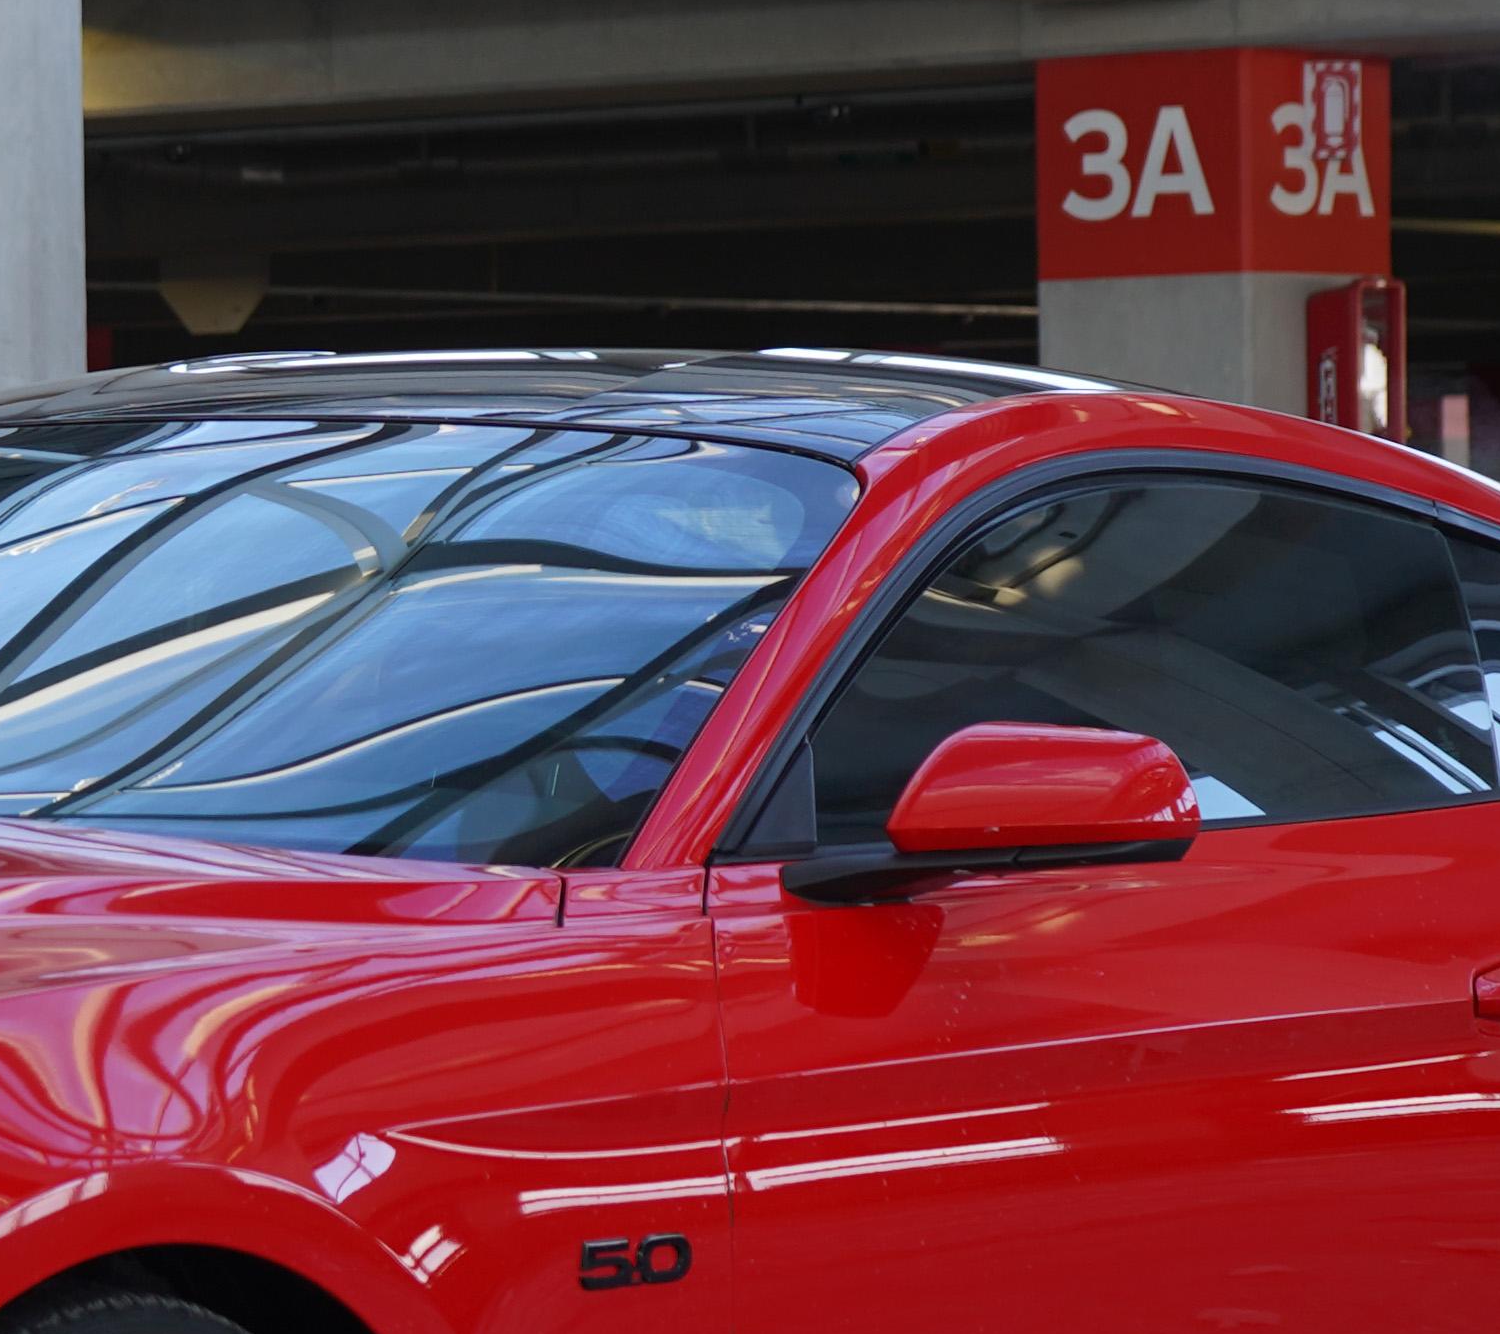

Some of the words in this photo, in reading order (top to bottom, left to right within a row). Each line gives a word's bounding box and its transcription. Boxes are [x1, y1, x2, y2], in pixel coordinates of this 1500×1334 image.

[1061, 105, 1214, 221] 3A
[1270, 103, 1375, 217] 3A
[578, 1232, 693, 1291] 5.0
